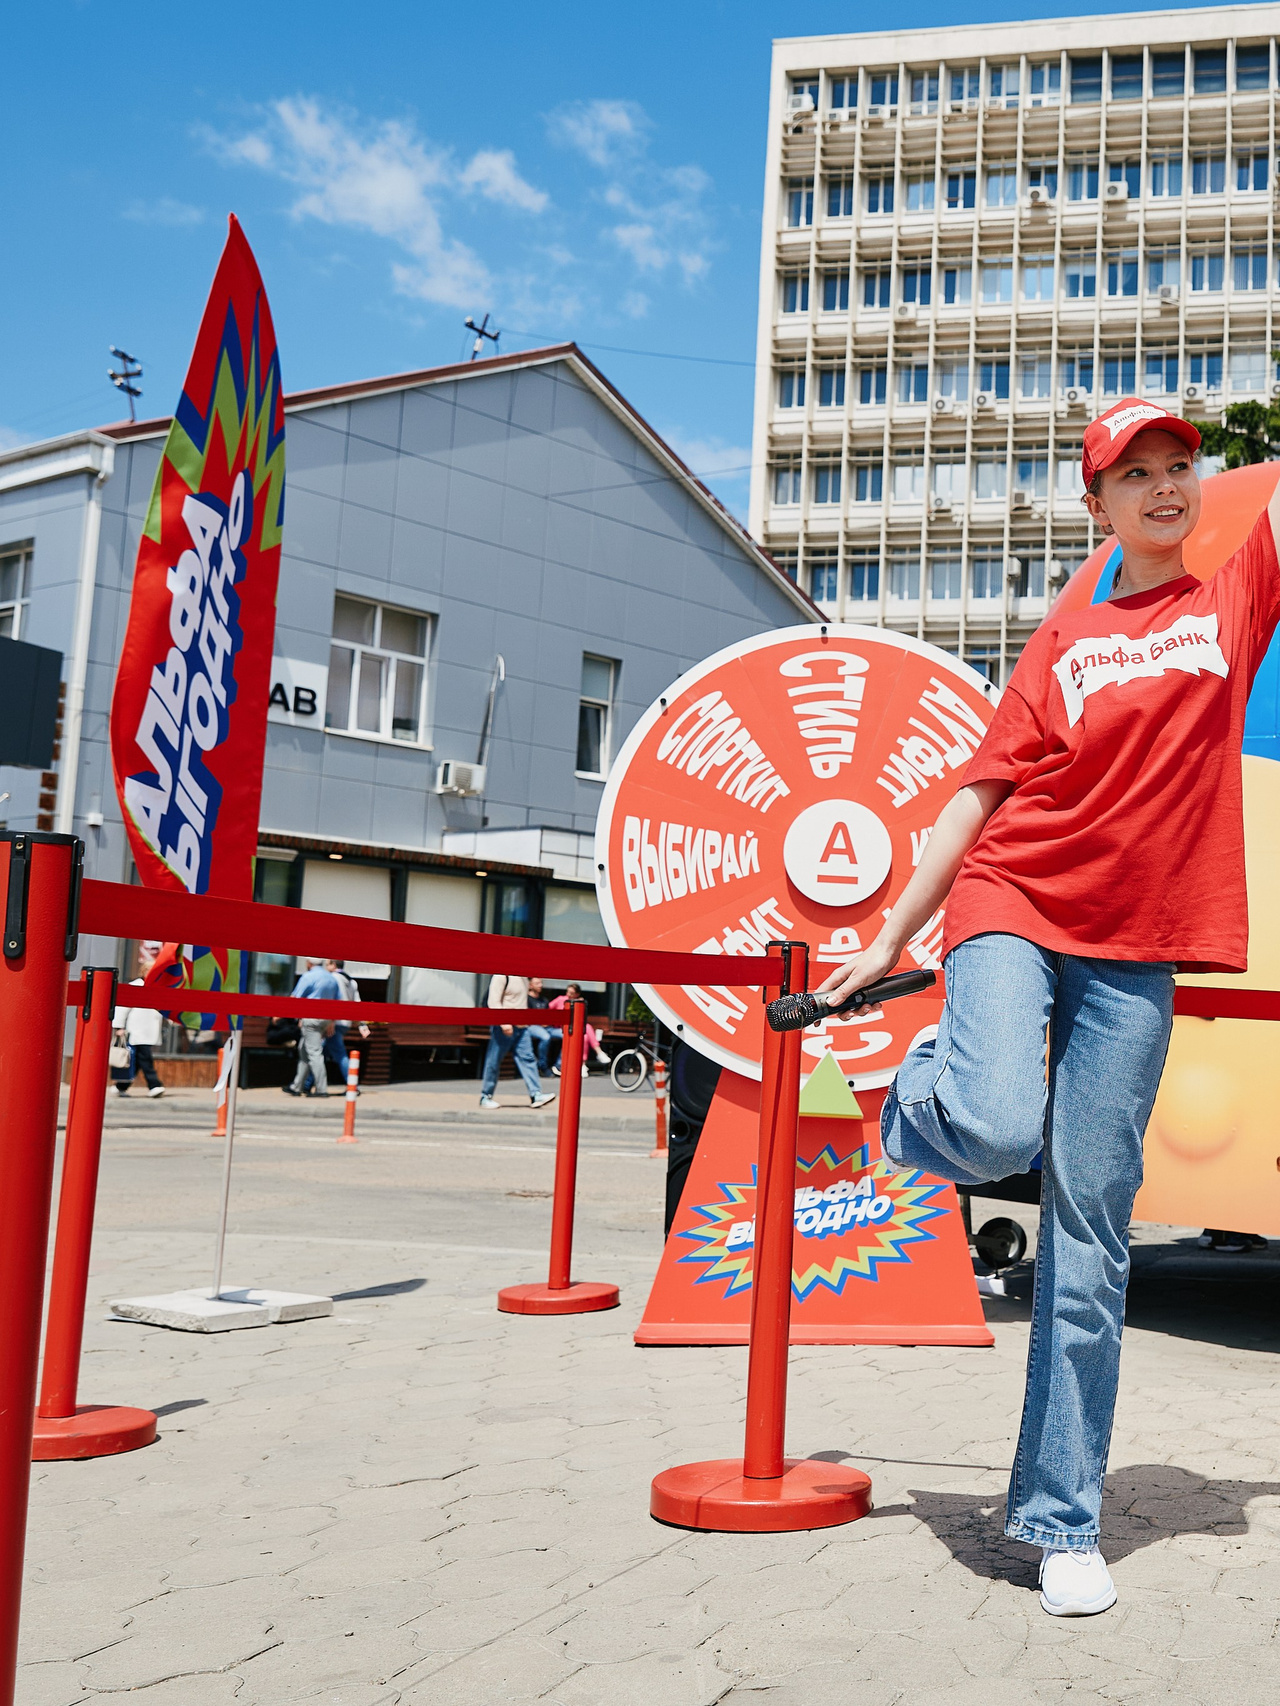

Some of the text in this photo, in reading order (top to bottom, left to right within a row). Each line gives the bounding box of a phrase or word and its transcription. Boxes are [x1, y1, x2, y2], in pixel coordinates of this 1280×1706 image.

[124, 494, 224, 852] АЛЬФА
[164, 471, 246, 962] ЫГОДНО
[779, 650, 870, 780] СТИЛЬ
[1070, 646, 1146, 690] Альфа
[656, 690, 792, 814] СПОРТКИТ
[875, 676, 989, 809] АУТФИТ
[622, 815, 761, 913] ВЫБИРАЙ
